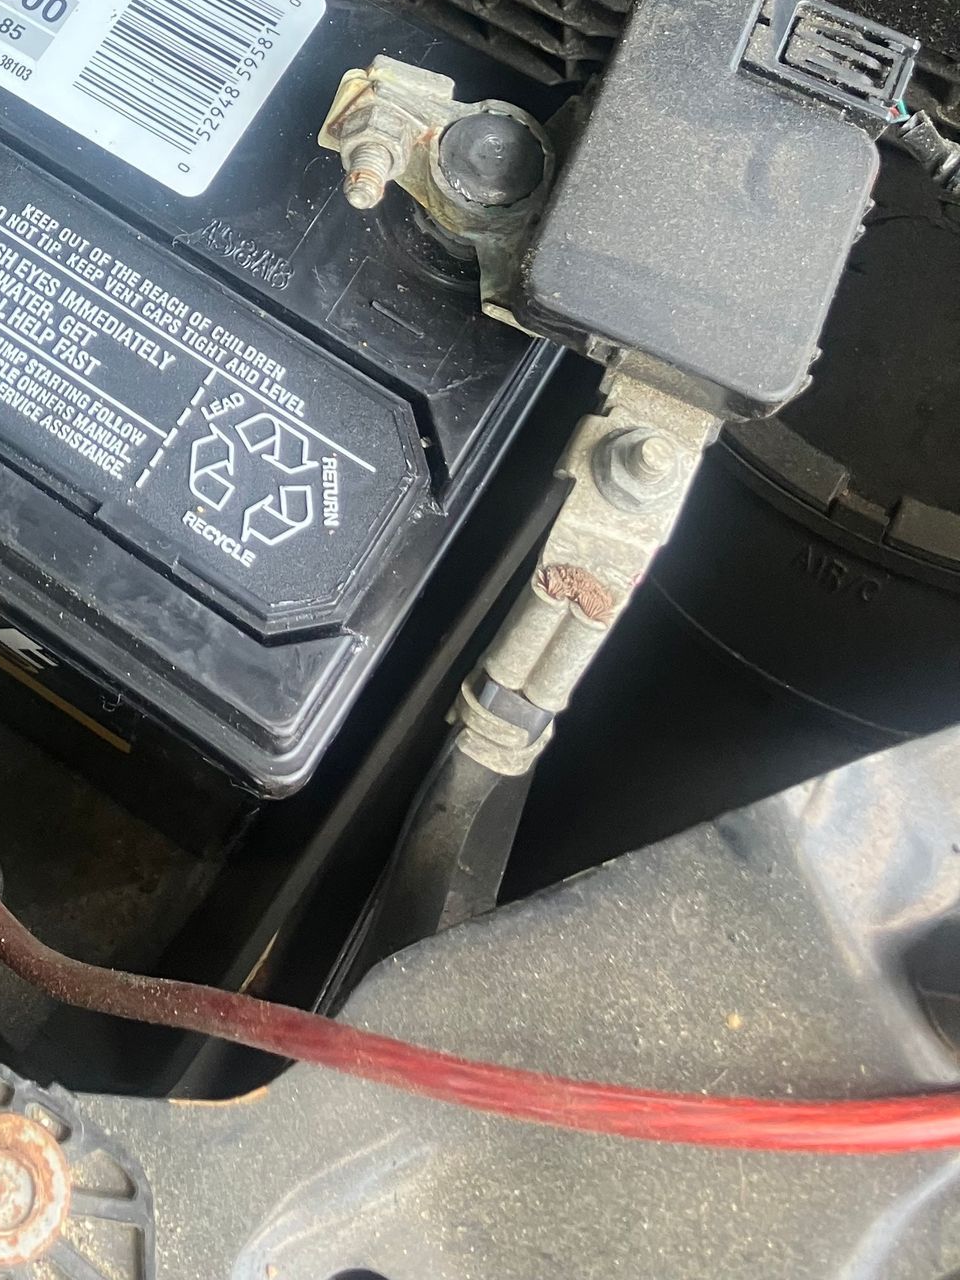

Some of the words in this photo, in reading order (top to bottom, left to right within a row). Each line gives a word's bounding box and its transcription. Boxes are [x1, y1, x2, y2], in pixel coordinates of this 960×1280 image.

[194, 80, 241, 142] 52948
[235, 25, 281, 82] 59581
[5, 212, 39, 240] NOT
[35, 231, 65, 260] TIP.
[64, 251, 105, 283] KEEP
[102, 274, 144, 309] VENT
[140, 300, 182, 335] CAPS
[180, 325, 228, 364] TIGHT
[224, 356, 261, 386] AND
[257, 376, 307, 418] LEVEL
[12, 256, 62, 298] EYES
[56, 285, 177, 372] IMMEDIATELY
[20, 202, 60, 234] KEEP
[57, 226, 91, 253] OUT
[87, 246, 112, 267] OF
[109, 259, 142, 288] THE
[137, 278, 190, 320] REACH
[187, 310, 213, 332] OF
[210, 324, 287, 383] CHILDREN
[57, 313, 98, 348] GET
[5, 306, 56, 346] HELP
[50, 335, 102, 377] FAST
[15, 374, 76, 422] OWNERS
[70, 411, 134, 464] MANUAL.
[23, 357, 92, 410] STARTING
[86, 399, 148, 447] FOLLOW
[201, 392, 245, 421] LEAD
[38, 413, 127, 481] ASSISTANCE.
[320, 456, 340, 528] RETURN
[181, 509, 257, 569] RECYCLE
